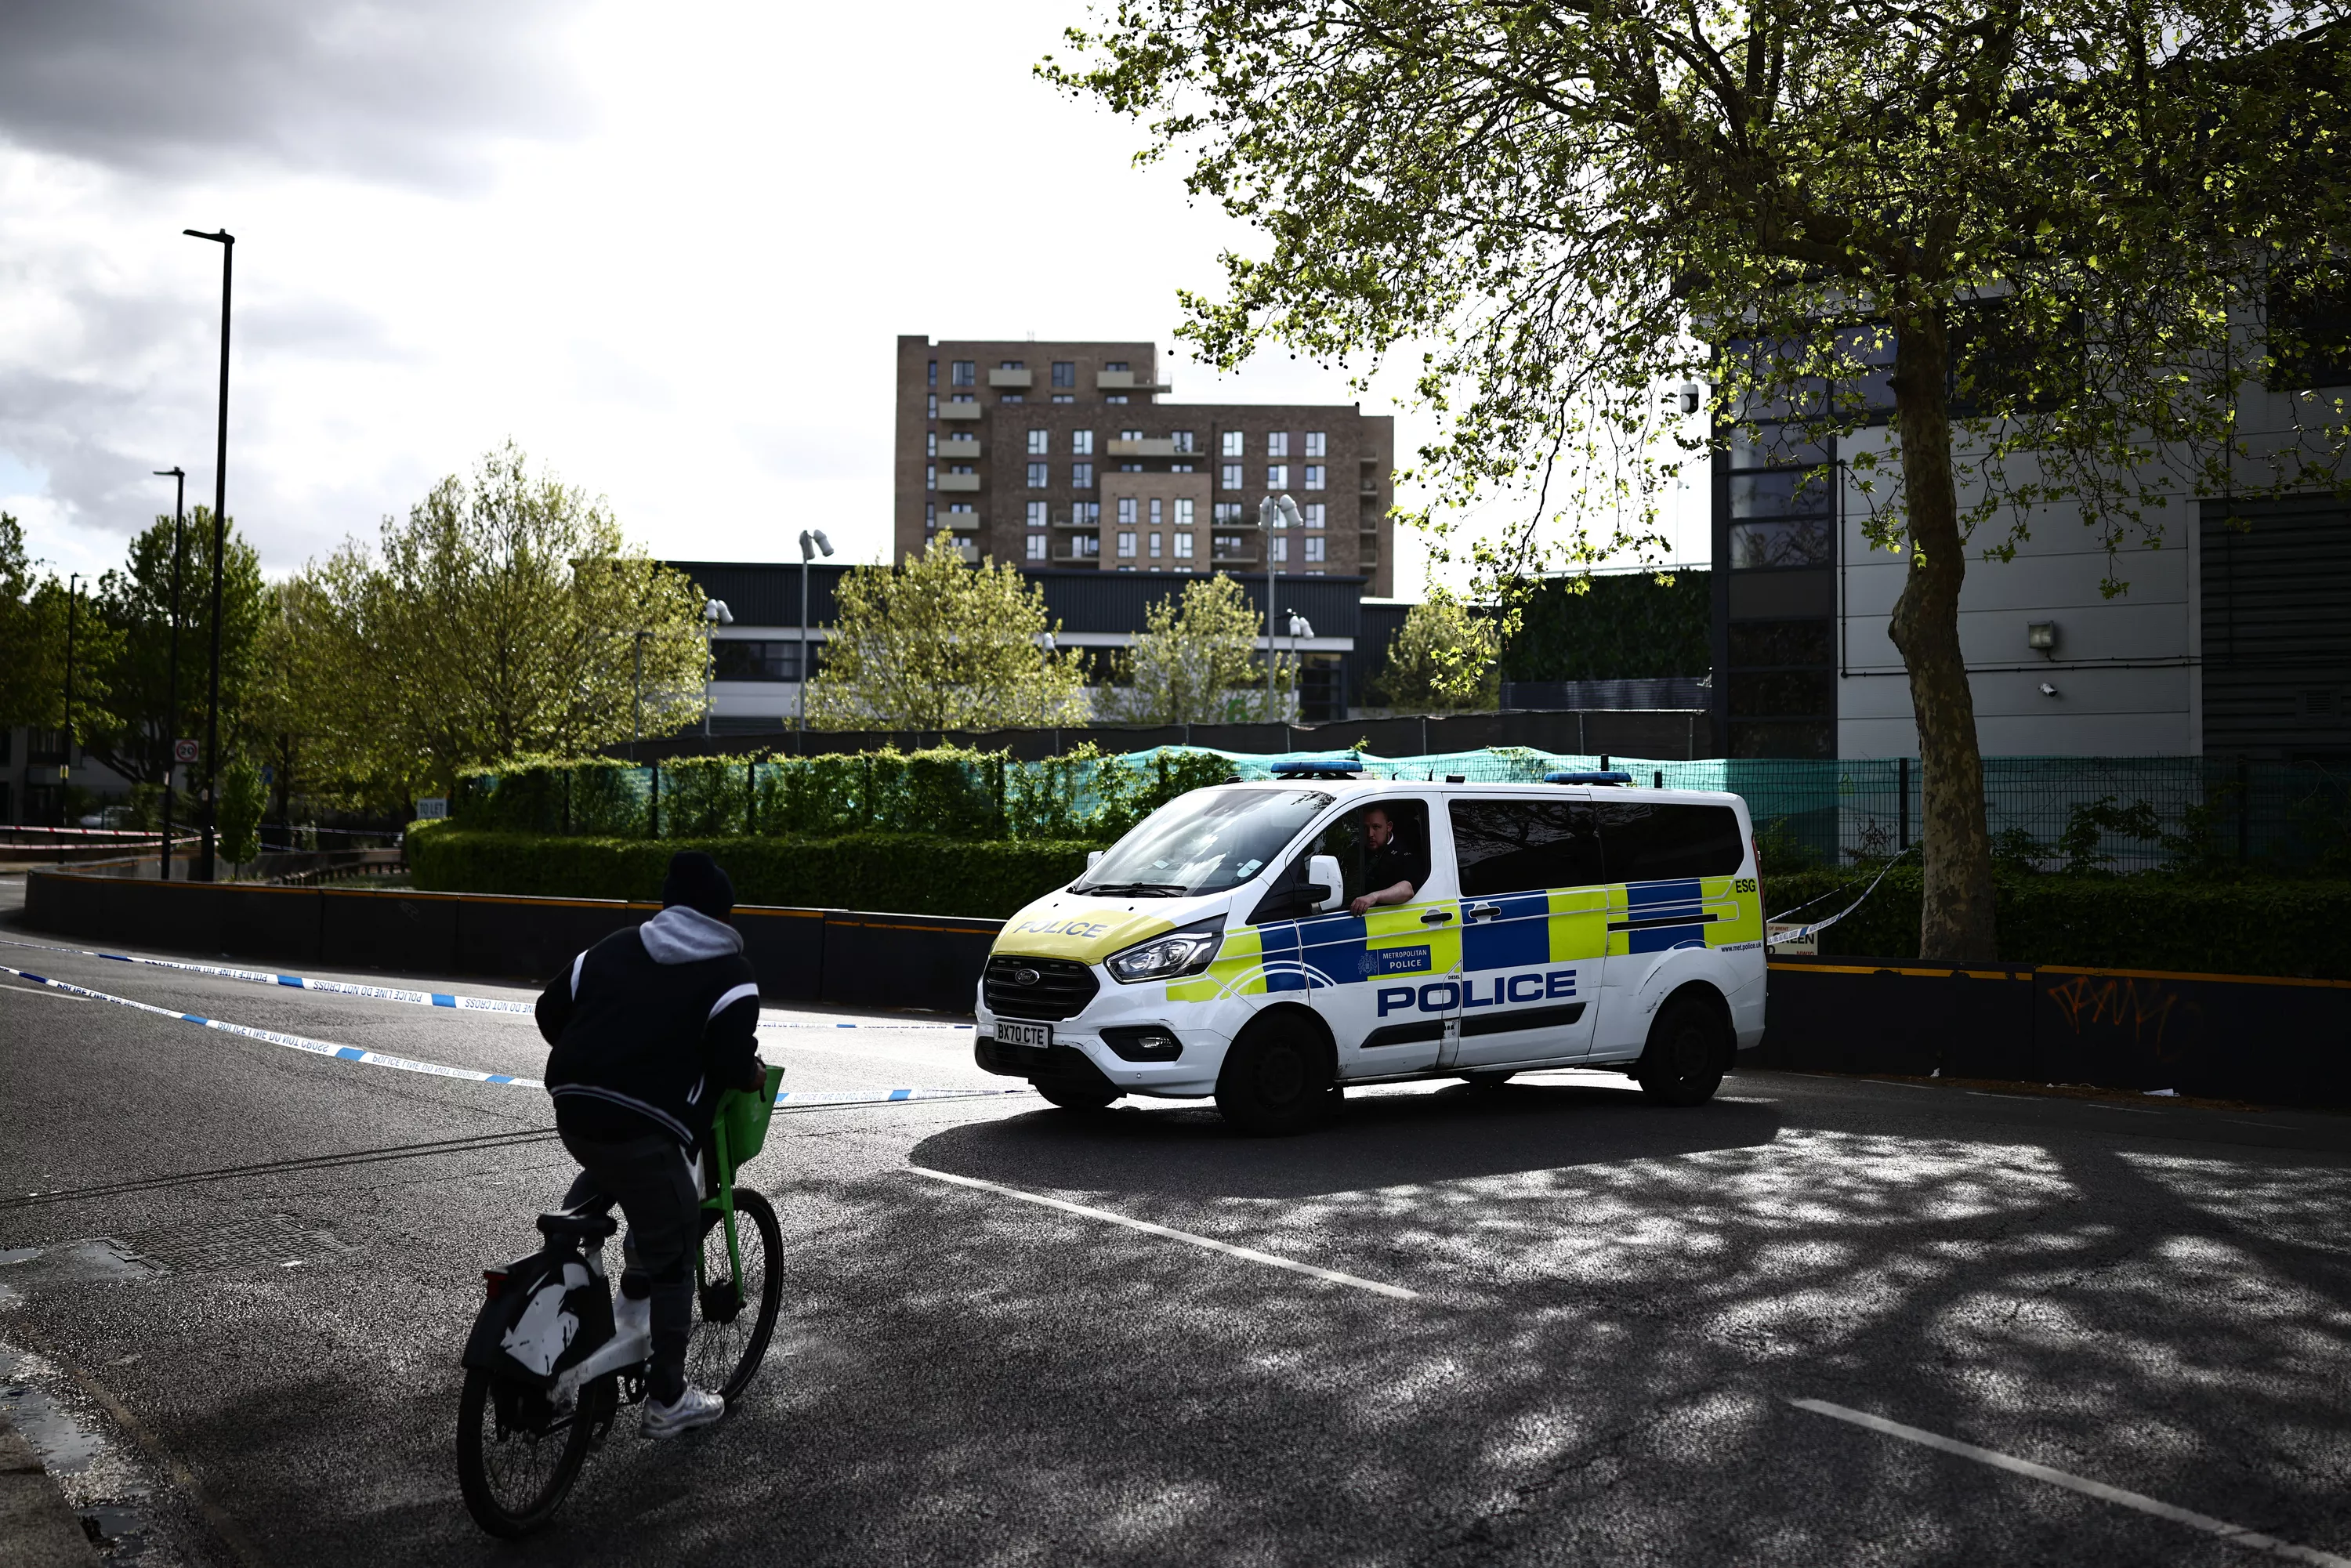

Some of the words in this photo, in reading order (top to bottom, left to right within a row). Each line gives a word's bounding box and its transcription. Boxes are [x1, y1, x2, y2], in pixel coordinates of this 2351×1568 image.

[180, 745, 195, 756] 20
[419, 802, 429, 815] TO
[429, 802, 444, 815] LET
[1735, 878, 1756, 893] ESG
[1012, 921, 1109, 938] POLICE
[1721, 942, 1762, 953] www.met.police.uk
[1382, 949, 1427, 959] METROPOLITAN
[1389, 959, 1422, 969] POLICE
[1018, 972, 1032, 980] Ford
[313, 980, 341, 993] CROSS
[342, 985, 359, 995] NOT
[361, 987, 372, 997] DO
[374, 987, 393, 999] LINE
[393, 990, 422, 1003] POLICE
[1377, 969, 1577, 1017] POLICE
[465, 998, 492, 1009] CROSS
[492, 1001, 509, 1011] NOT
[510, 1003, 521, 1012] DO
[522, 1004, 536, 1014] INE
[998, 1023, 1021, 1042] BX70
[1023, 1027, 1044, 1045] CTE
